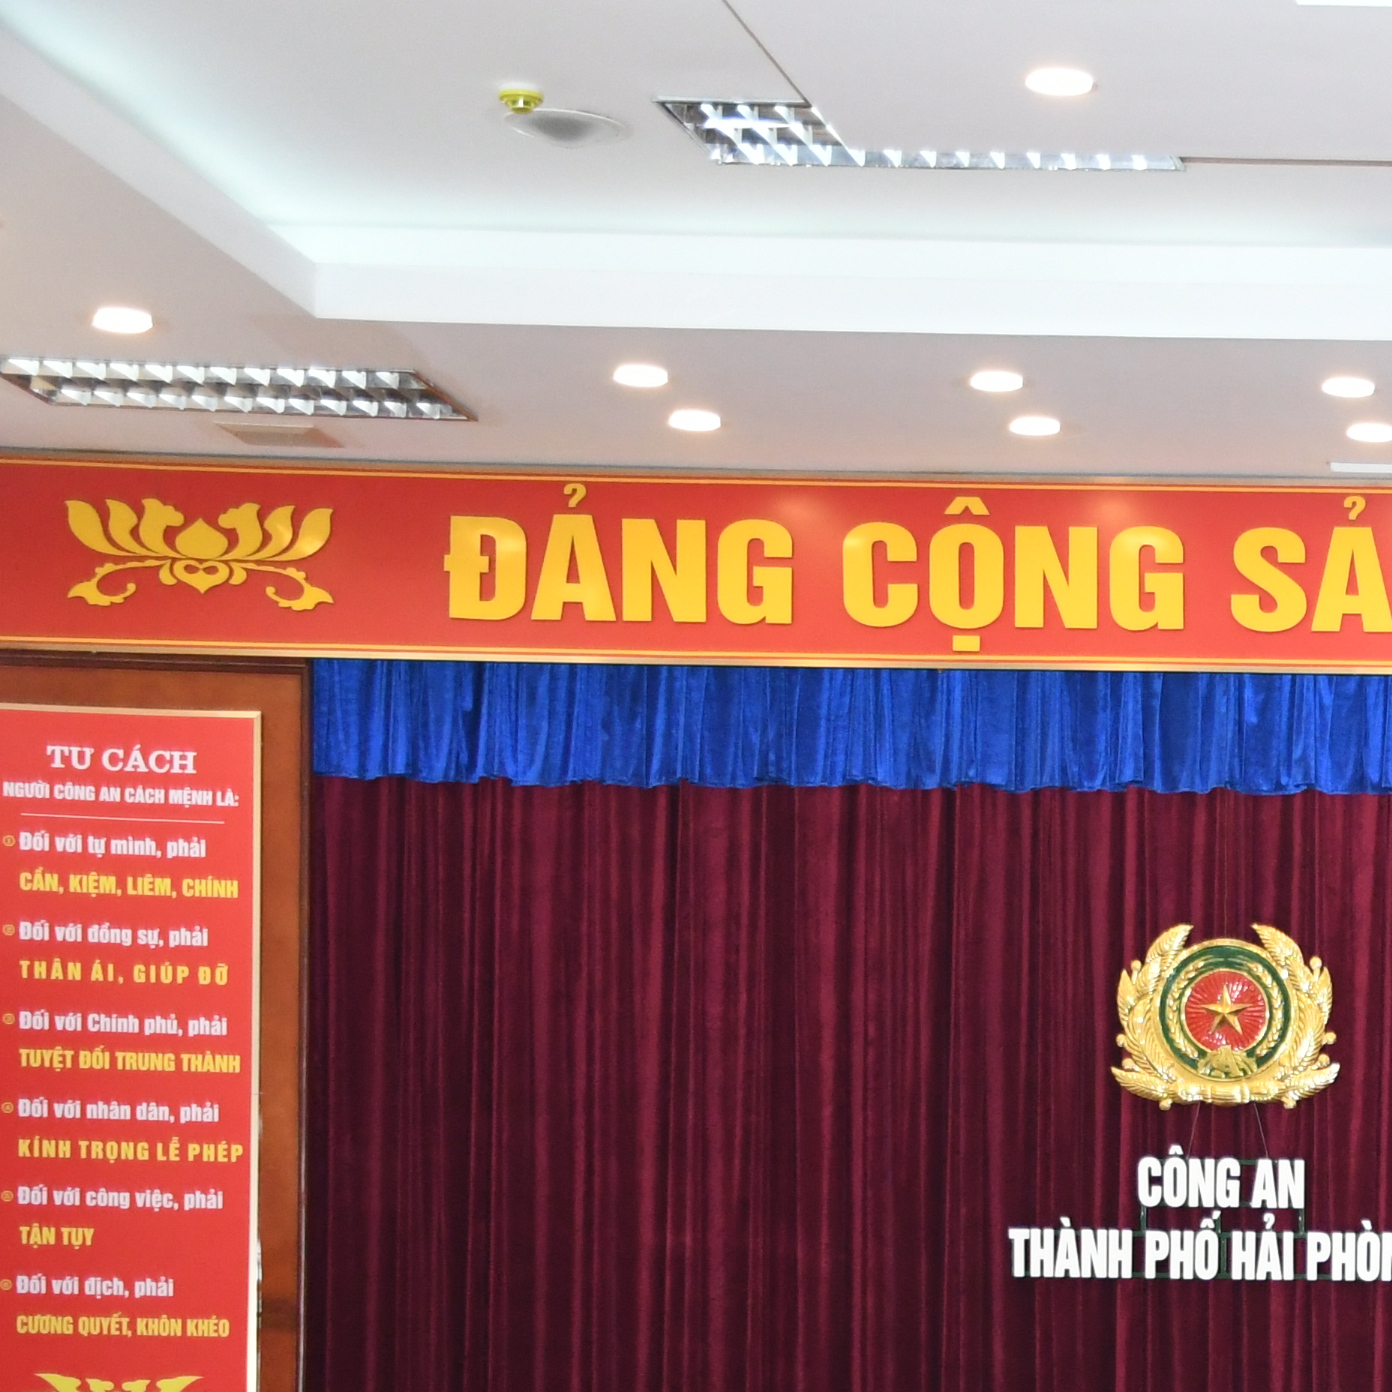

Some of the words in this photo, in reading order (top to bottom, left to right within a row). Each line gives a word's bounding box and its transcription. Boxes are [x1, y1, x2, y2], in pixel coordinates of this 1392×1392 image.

[443, 483, 793, 625] ĐẢNG
[842, 496, 1185, 651] CỘNG
[47, 746, 94, 769] TƯ
[102, 746, 197, 774] CÁCH
[54, 782, 95, 800] CÔNG
[99, 787, 120, 802] AN
[125, 786, 164, 803] CÁCH
[169, 787, 212, 807] MỆNH
[216, 788, 238, 806] LÀ:
[20, 830, 49, 851] Đối
[55, 834, 82, 852] với
[167, 837, 206, 858] phải
[70, 872, 121, 897] KIỆM,
[127, 874, 176, 898] LIÊM,
[182, 876, 238, 898] CHÍNH
[19, 920, 49, 940] Đối
[55, 924, 82, 942] với
[88, 922, 132, 946] đồng
[138, 929, 164, 948] sự,
[169, 926, 208, 947] phải
[20, 958, 81, 980] THÂN
[91, 960, 123, 984] ÁI,
[134, 962, 189, 984] GIÚP
[20, 1010, 49, 1030] Đối
[55, 1013, 82, 1031] với
[88, 1014, 139, 1032] Chính
[144, 1014, 182, 1036] phủ,
[188, 1015, 227, 1036] phải
[20, 1046, 74, 1071] TUYỆT
[79, 1046, 110, 1069] ĐỐI
[116, 1052, 175, 1071] TRUNG
[181, 1051, 240, 1073] THÀNH
[18, 1097, 48, 1117] Đối
[54, 1100, 80, 1118] với
[86, 1101, 130, 1120] nhân
[136, 1102, 174, 1123] dân,
[180, 1102, 219, 1123] phải
[19, 1136, 70, 1158] KÍNH
[79, 1141, 148, 1163] TRỌNG
[157, 1137, 180, 1161] LỄ
[188, 1141, 243, 1162] PHÉP
[1138, 1145, 1240, 1207] CÔNG
[1250, 1159, 1304, 1208] AN
[18, 1184, 47, 1204] Đối
[53, 1188, 80, 1205] với
[86, 1188, 130, 1209] công
[135, 1189, 178, 1211] việc,
[184, 1189, 223, 1210] phải
[20, 1223, 55, 1248] TẬN
[61, 1228, 94, 1249] TỤY
[1009, 1217, 1132, 1278] THÀNH
[1145, 1214, 1220, 1280] PHỐ
[1232, 1214, 1295, 1280] HẢI
[16, 1274, 46, 1294] Đối
[52, 1276, 78, 1294] với
[85, 1277, 129, 1298] địch,
[135, 1276, 173, 1298] phải
[78, 1312, 132, 1336] QUYẾT,
[137, 1315, 182, 1336] KHÔN
[187, 1316, 230, 1337] KHÉO
